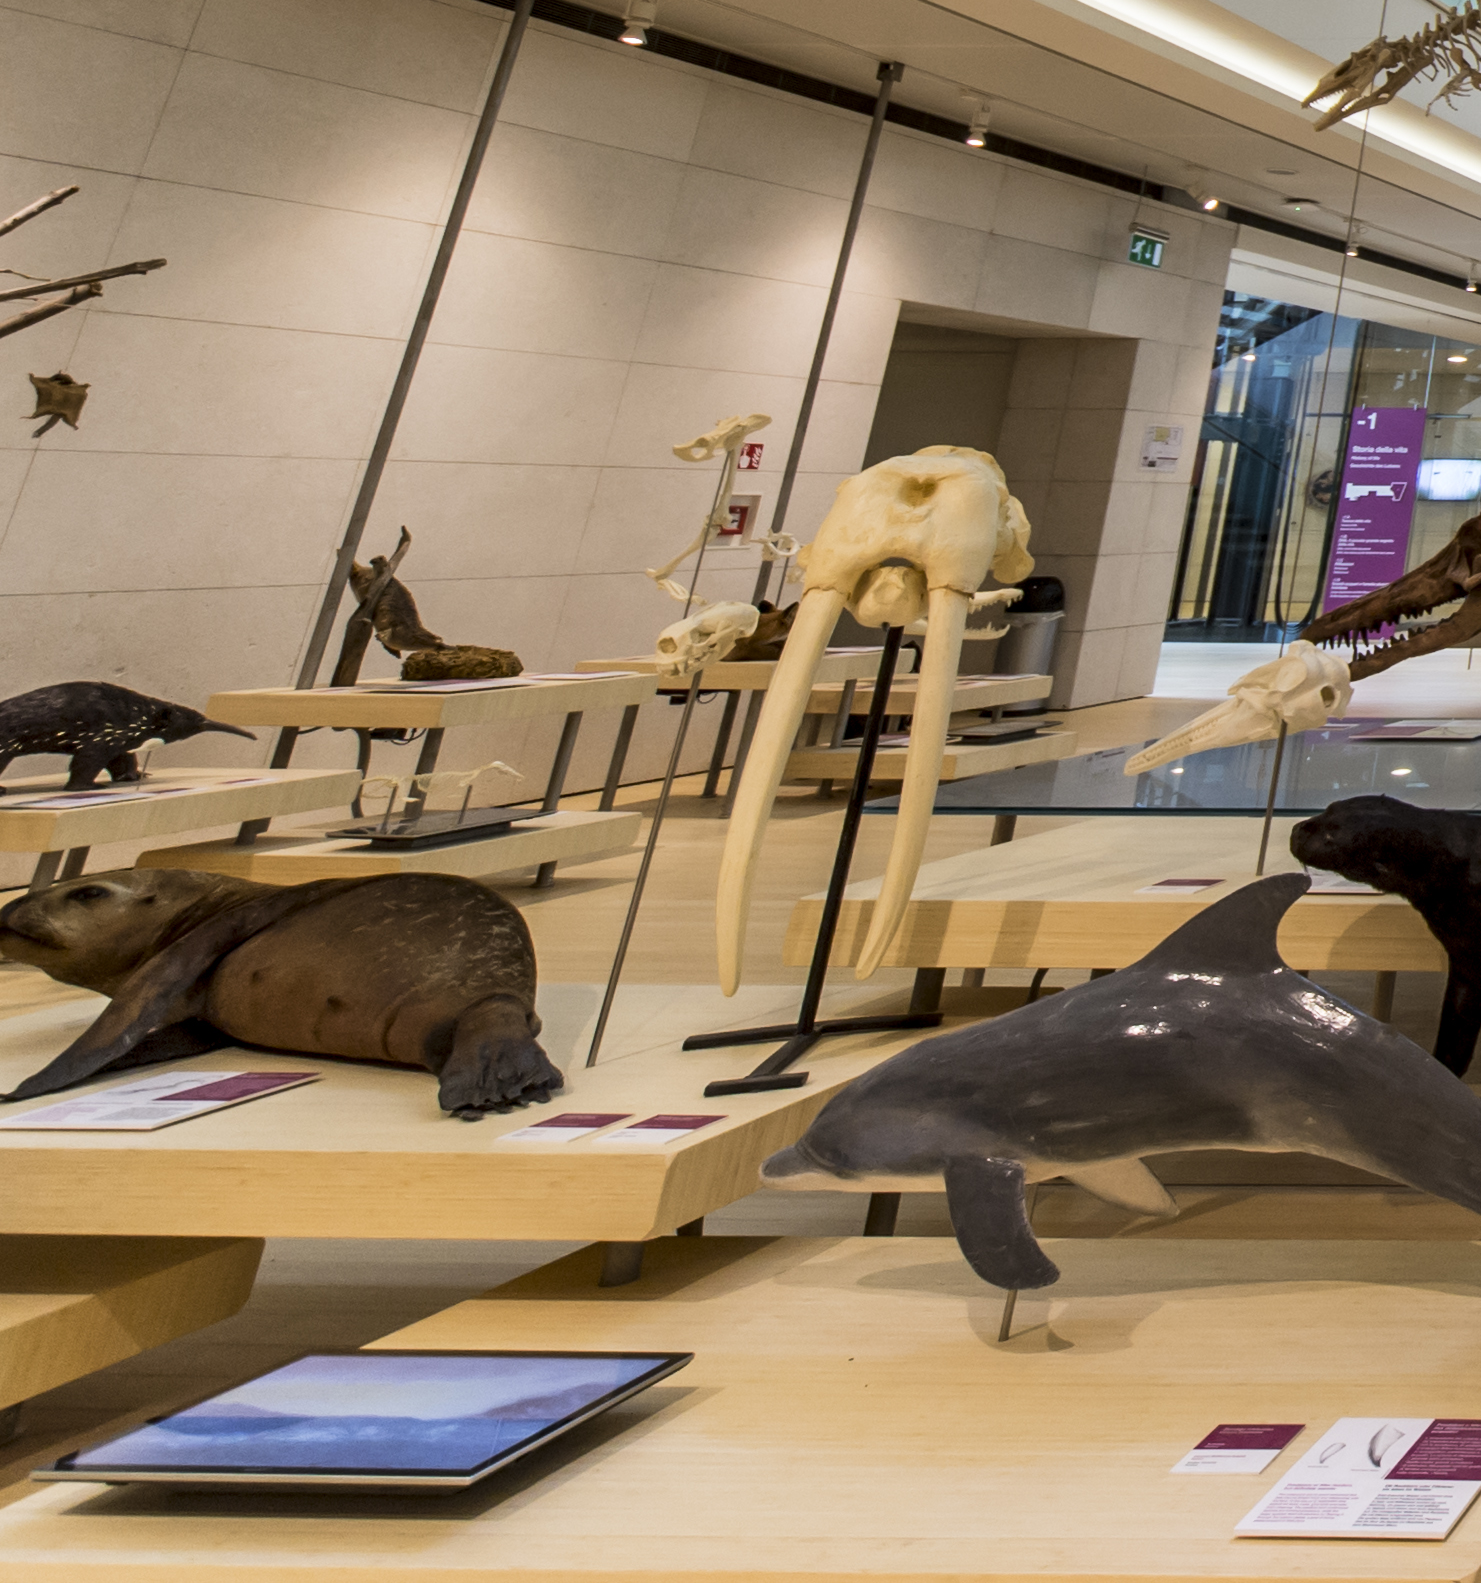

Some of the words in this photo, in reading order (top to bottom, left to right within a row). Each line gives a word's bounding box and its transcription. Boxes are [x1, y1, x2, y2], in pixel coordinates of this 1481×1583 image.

[1357, 412, 1377, 430] -1
[1352, 445, 1375, 453] Storia
[1375, 446, 1394, 454] della
[1394, 446, 1409, 454] vita
